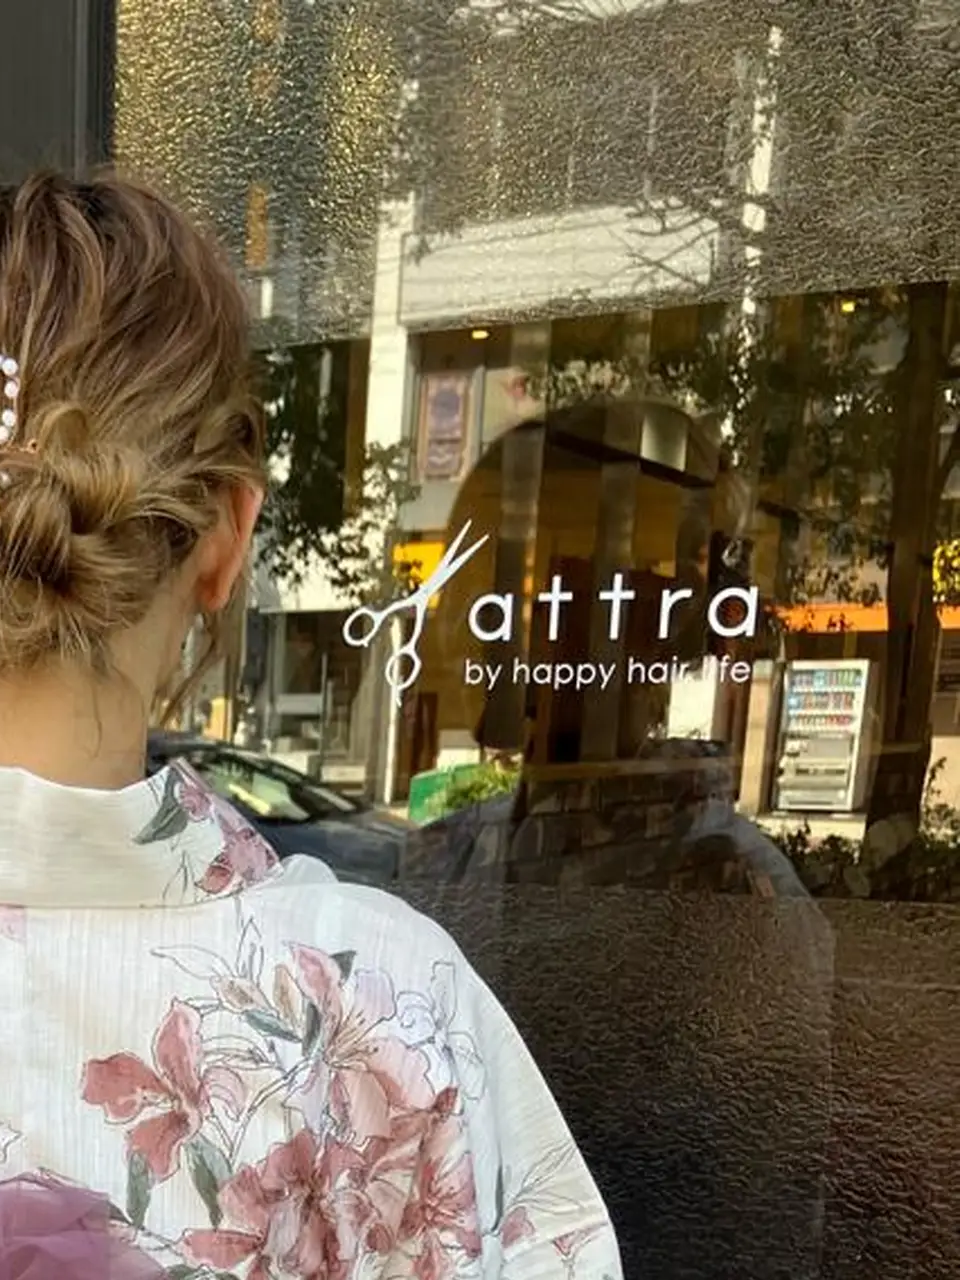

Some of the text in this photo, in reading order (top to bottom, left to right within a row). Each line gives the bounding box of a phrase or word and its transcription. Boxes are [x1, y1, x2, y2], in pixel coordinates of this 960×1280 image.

[468, 572, 759, 641] attra
[464, 658, 502, 690] by
[512, 656, 616, 690] happy
